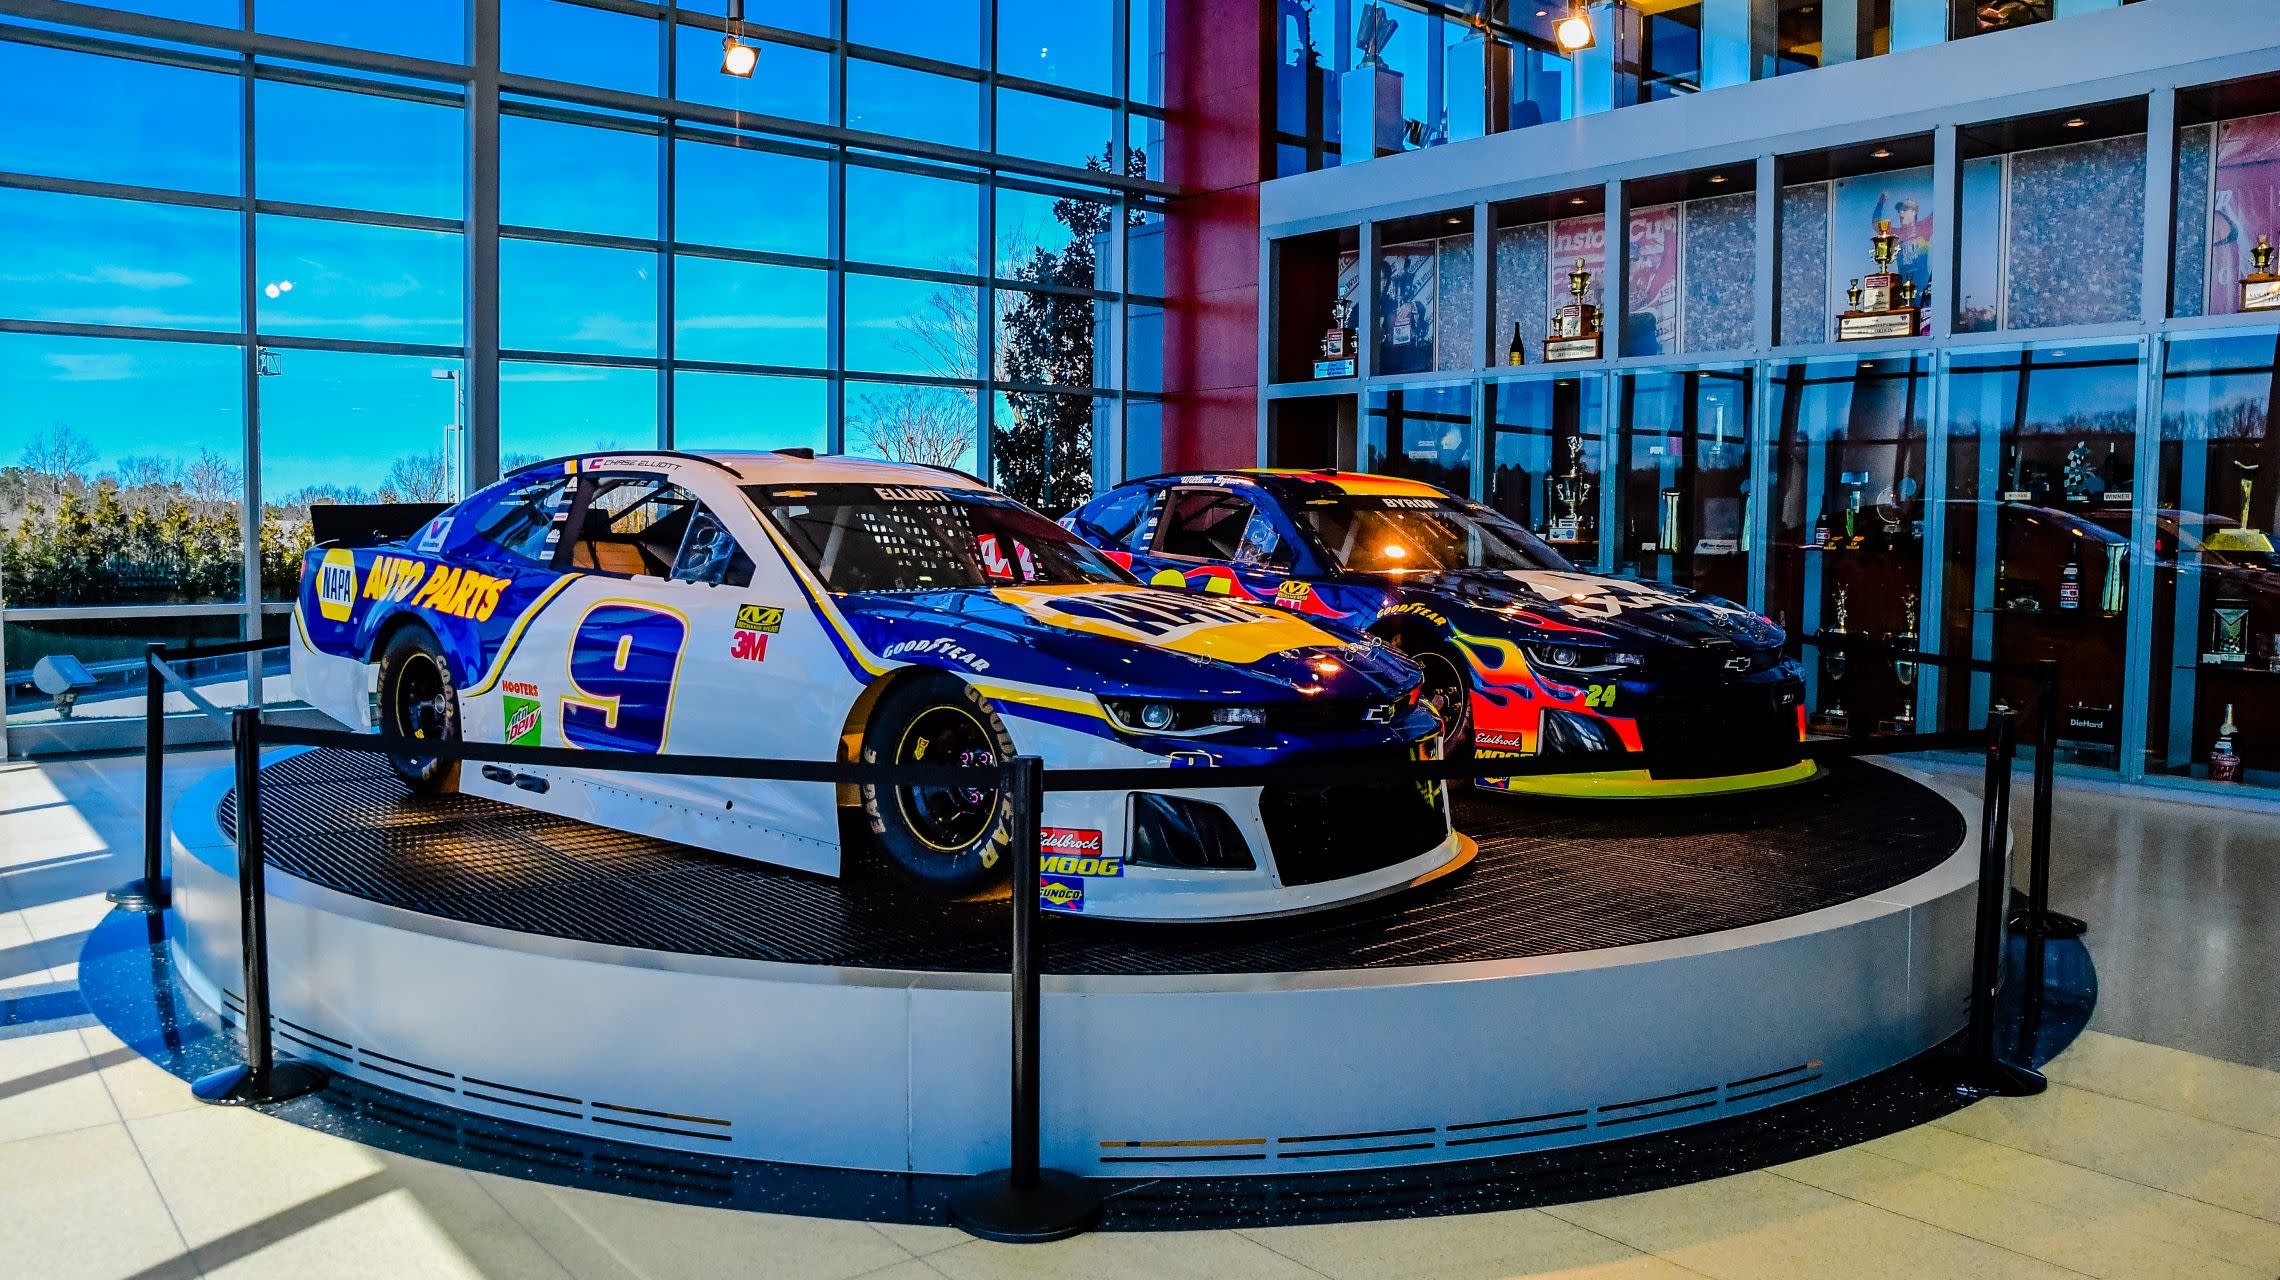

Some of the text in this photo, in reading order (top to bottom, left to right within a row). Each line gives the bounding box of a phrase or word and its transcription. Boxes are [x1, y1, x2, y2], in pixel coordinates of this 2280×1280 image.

[638, 460, 682, 471] ELLIOTT
[1181, 475, 1213, 484] William
[874, 487, 951, 502] ELLIOTT
[1382, 498, 1439, 509] BYRON
[322, 566, 351, 603] NAPA
[362, 555, 512, 623] AUTO PARTS
[1377, 602, 1447, 627] GOODYEAR
[731, 630, 769, 662] 3M
[882, 637, 990, 672] GOODYEAR
[559, 597, 691, 755] 9
[502, 680, 538, 697] HOOTERS
[1584, 684, 1616, 708] 24
[2070, 718, 2104, 729] DieHard
[1475, 732, 1521, 748] Edelbrock
[1040, 855, 1120, 876] MOOG
